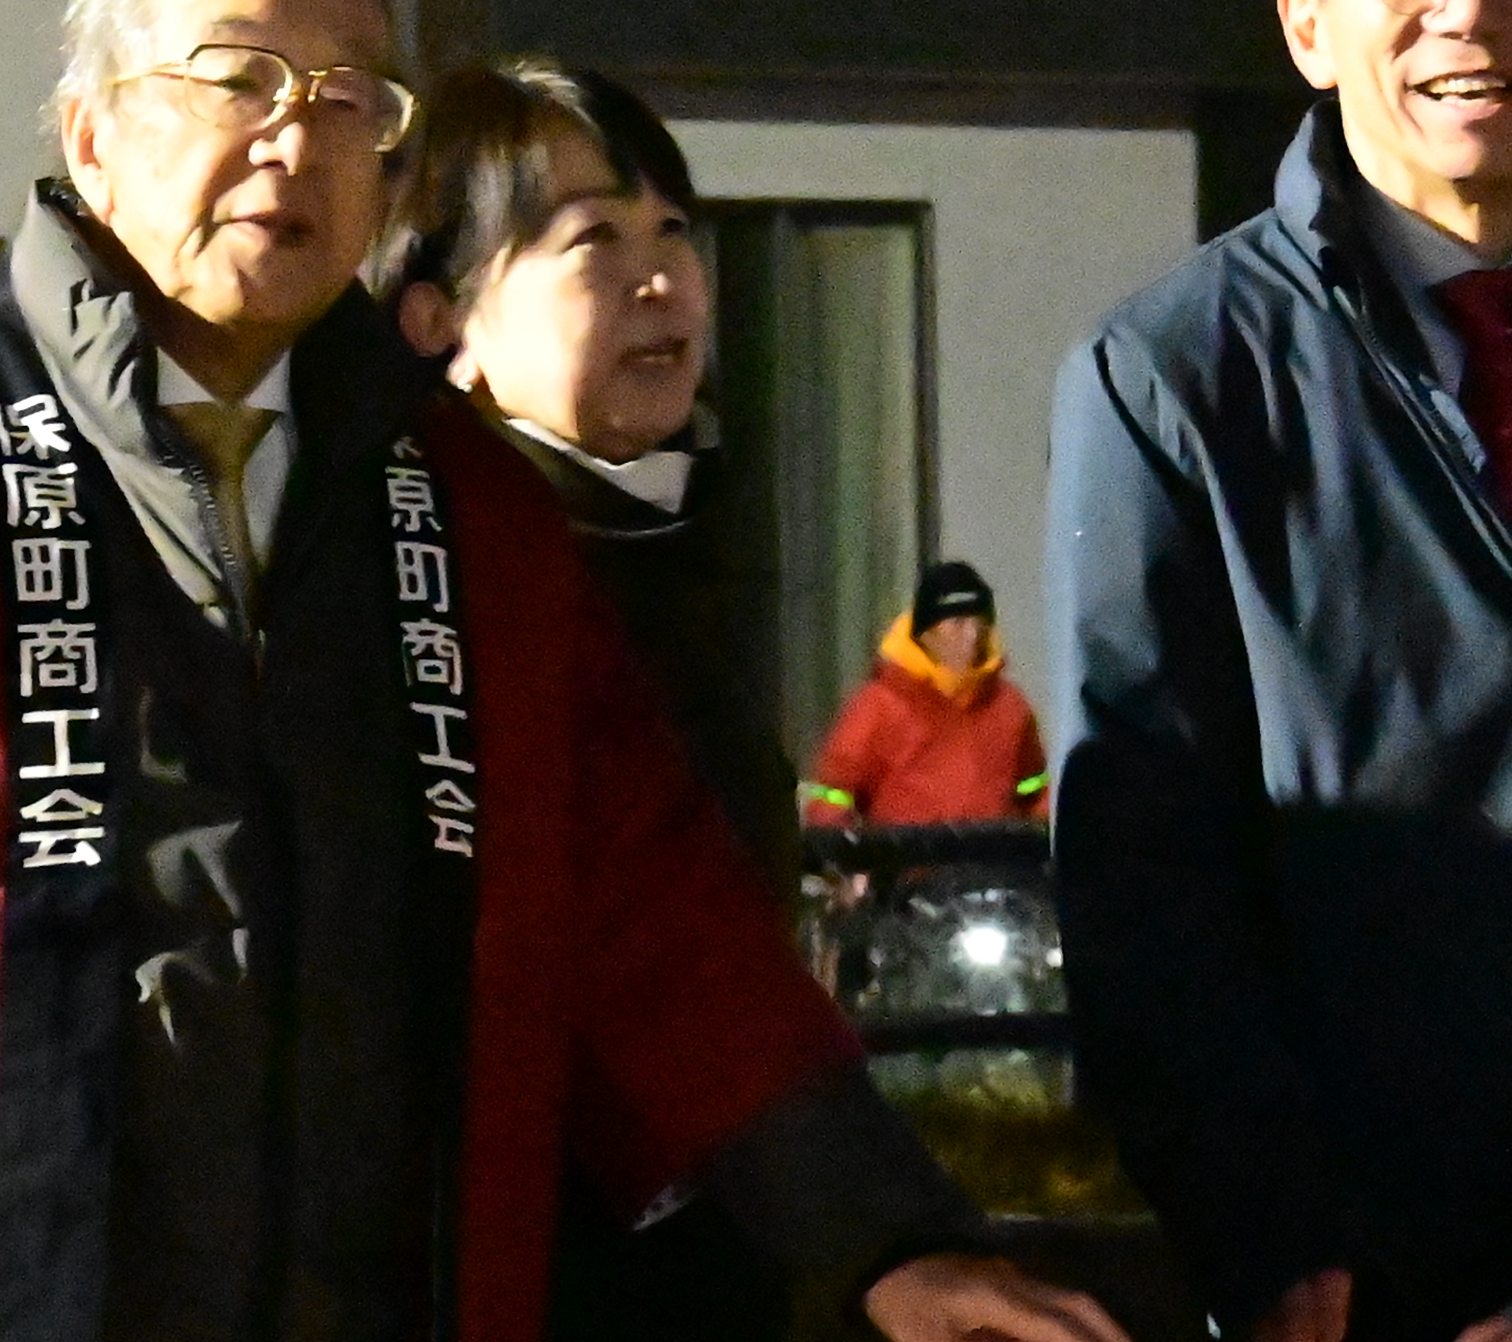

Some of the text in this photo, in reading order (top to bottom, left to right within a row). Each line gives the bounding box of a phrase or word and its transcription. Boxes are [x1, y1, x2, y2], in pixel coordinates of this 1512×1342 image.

[385, 435, 476, 858] 原町商工会
